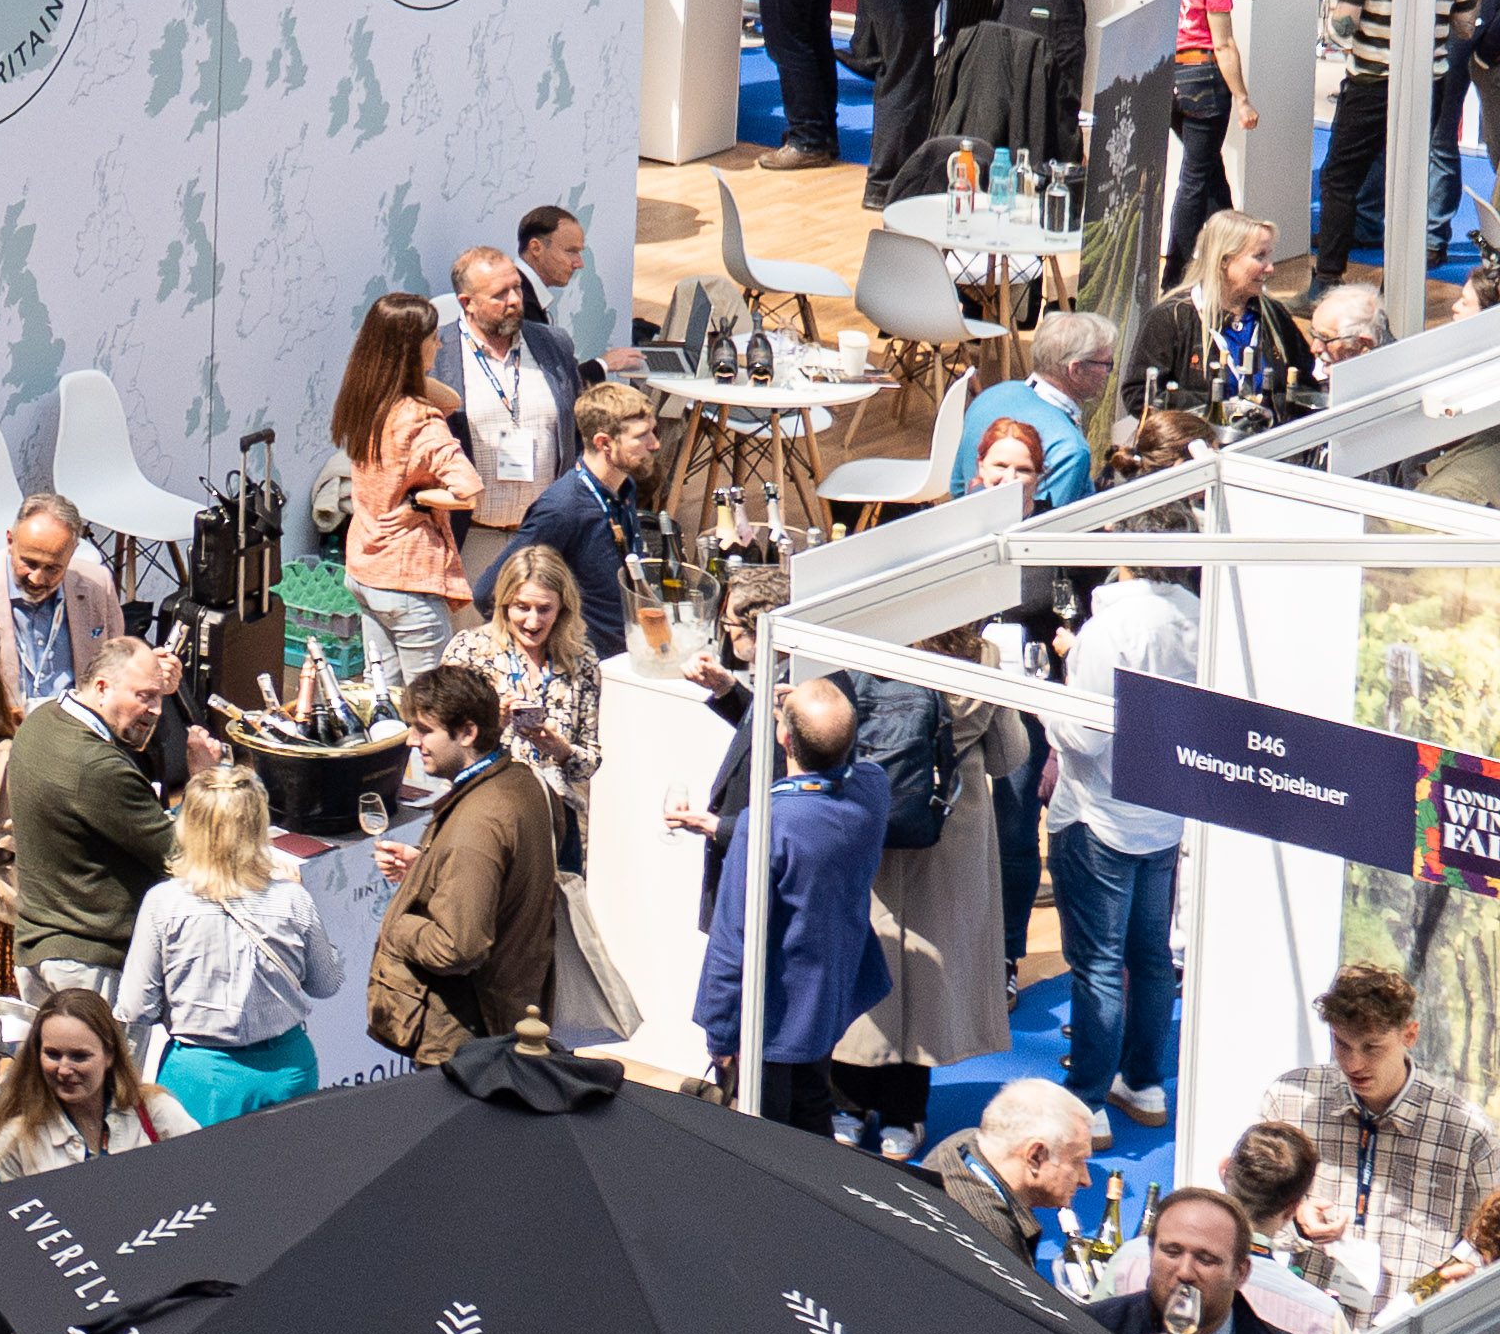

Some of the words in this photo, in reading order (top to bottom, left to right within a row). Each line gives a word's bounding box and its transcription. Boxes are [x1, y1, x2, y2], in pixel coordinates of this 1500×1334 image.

[1247, 730, 1286, 758] B46
[1175, 745, 1256, 783] Weingut
[1257, 766, 1350, 807] Spielauer
